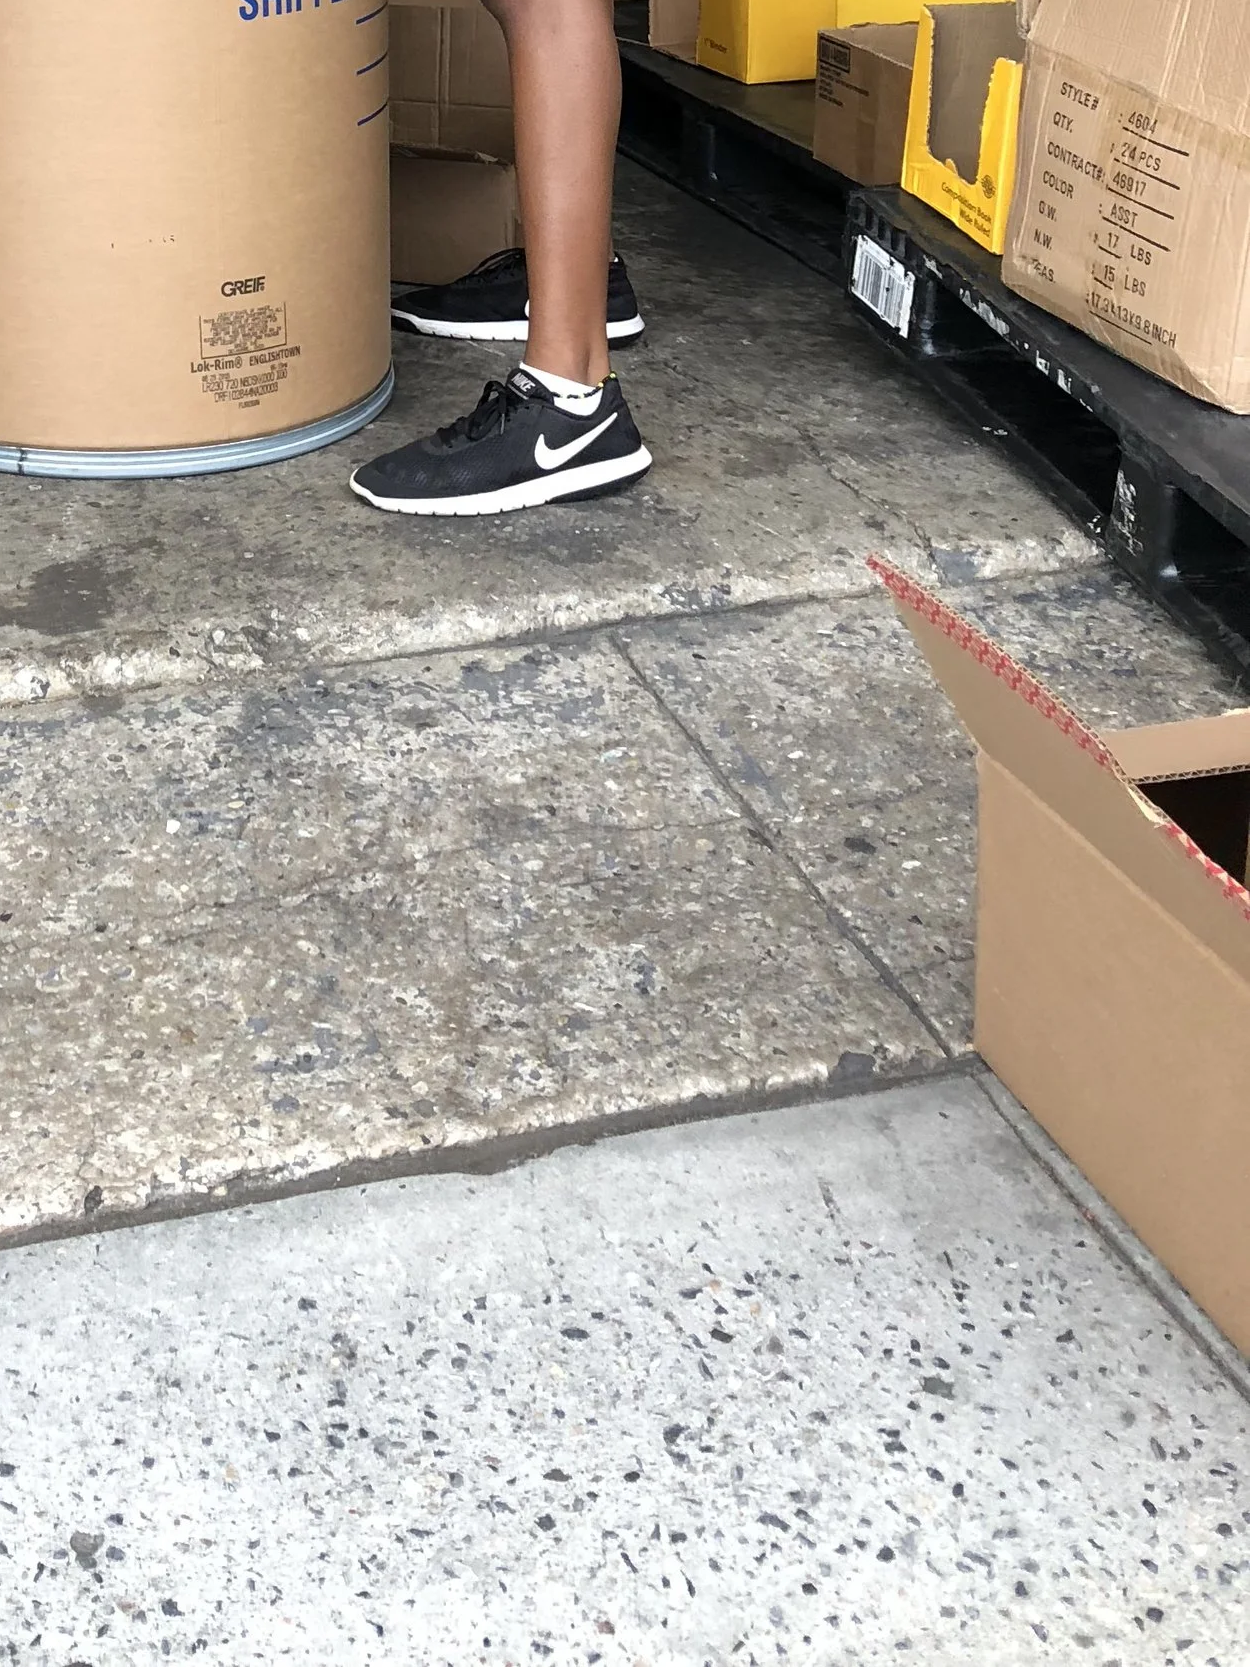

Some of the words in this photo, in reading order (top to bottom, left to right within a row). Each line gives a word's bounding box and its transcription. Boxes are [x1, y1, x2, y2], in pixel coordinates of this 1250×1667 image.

[1127, 110, 1159, 135] 4604
[1121, 141, 1137, 162] 24
[1139, 150, 1161, 172] PCS
[1042, 170, 1075, 200] COLOR
[1112, 170, 1147, 197] 46917
[1110, 203, 1139, 228] ASST
[1107, 231, 1120, 249] 17
[1130, 244, 1153, 267] LBS
[221, 275, 265, 297] GREIF
[1103, 264, 1116, 283] 15
[1124, 273, 1147, 297] LBS
[1151, 321, 1178, 350] INCH
[249, 345, 301, 367] ENGLISHTOWN
